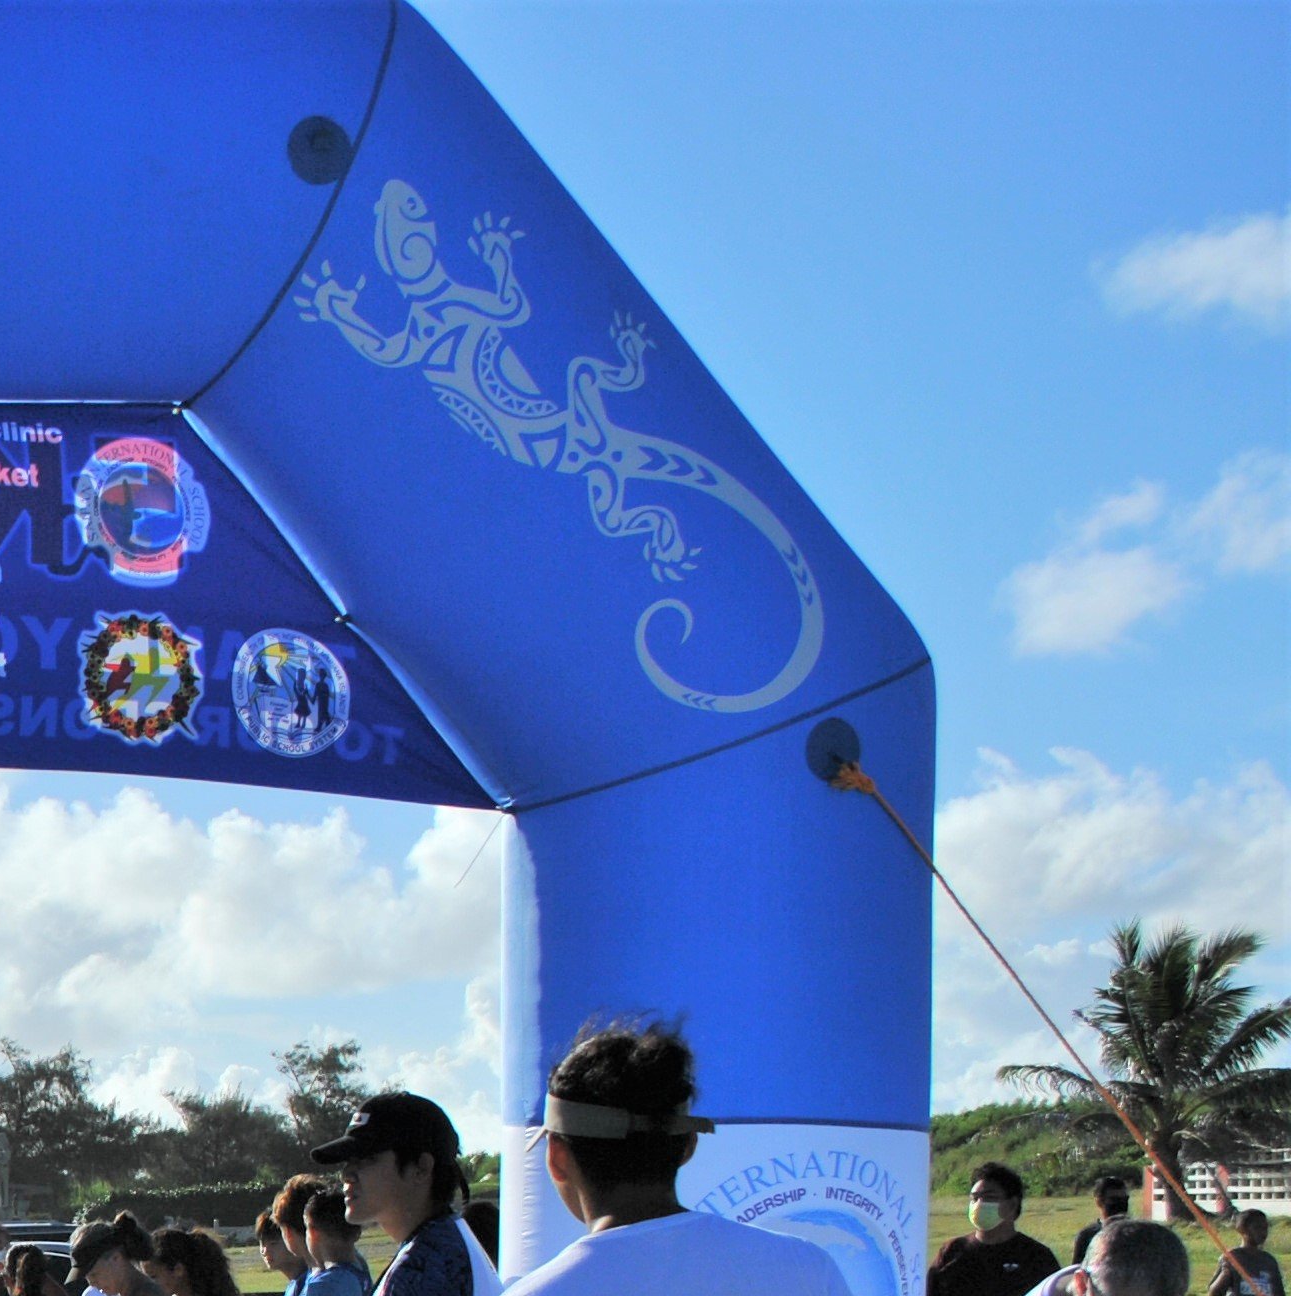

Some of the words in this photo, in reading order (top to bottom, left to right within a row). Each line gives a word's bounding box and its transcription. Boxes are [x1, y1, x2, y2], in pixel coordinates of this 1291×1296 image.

[695, 1150, 913, 1240] TERNATIONAL
[736, 1187, 807, 1223] ADERSHIP
[825, 1186, 885, 1221] INTEGRITY
